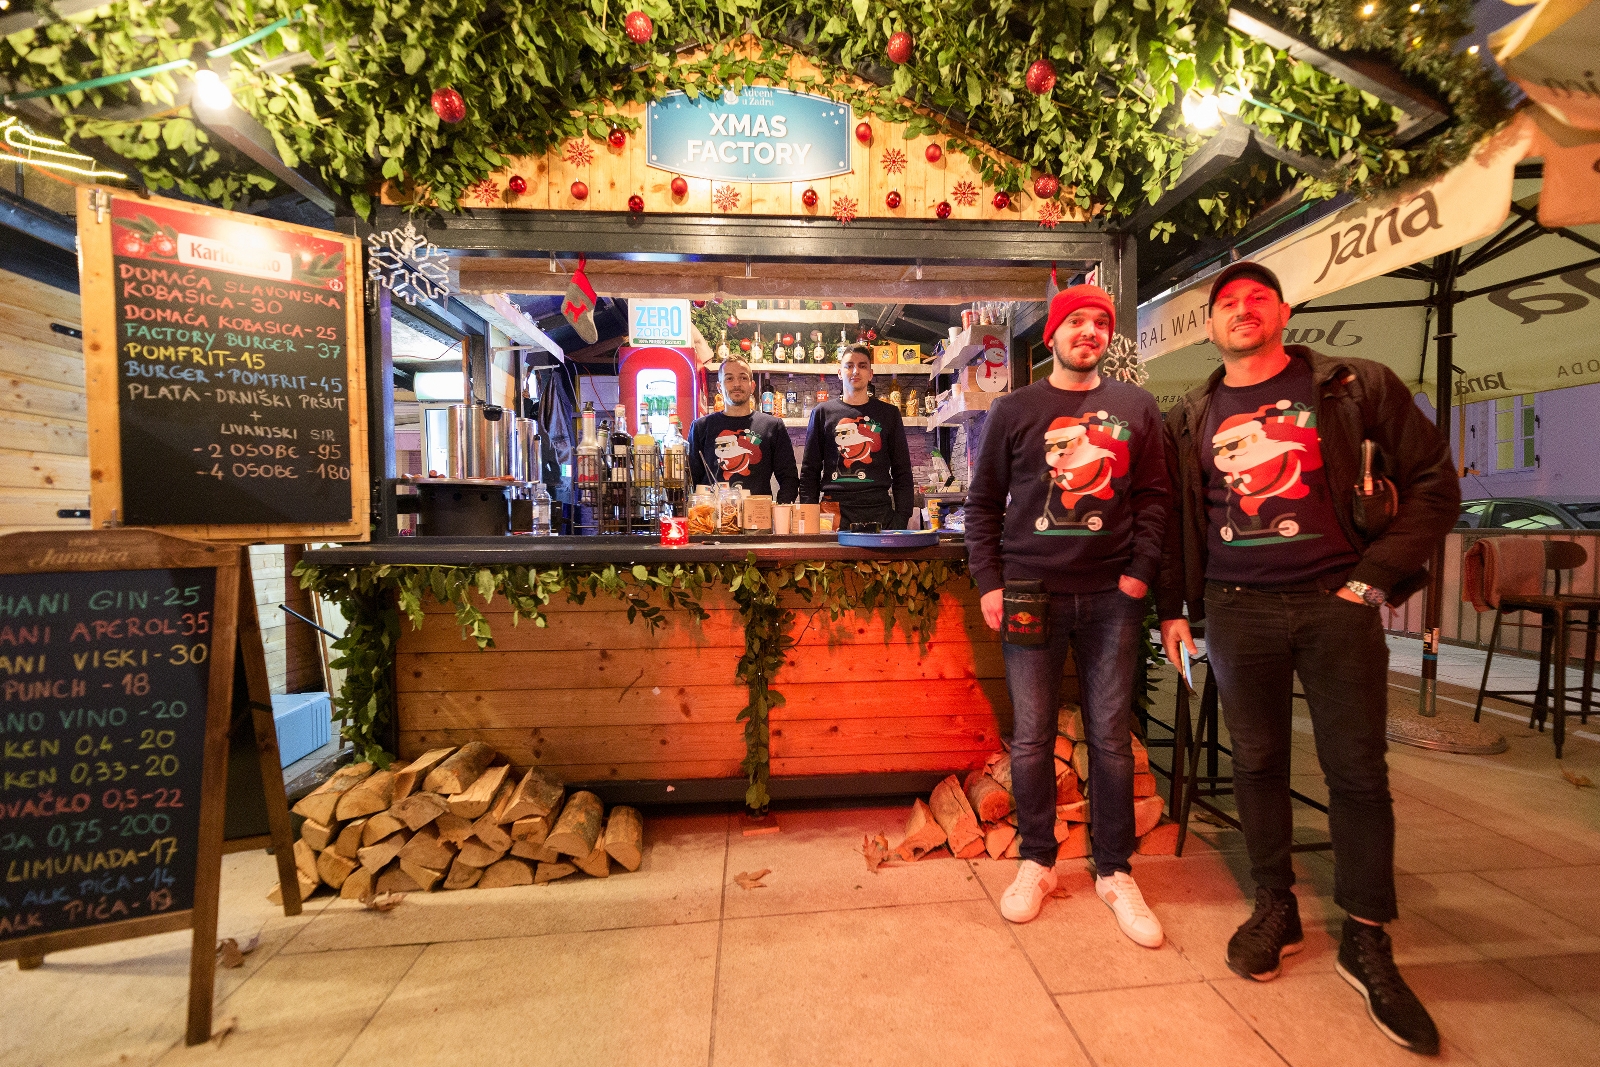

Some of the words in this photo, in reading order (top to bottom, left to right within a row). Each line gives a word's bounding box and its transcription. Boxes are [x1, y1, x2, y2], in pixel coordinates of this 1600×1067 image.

[709, 112, 787, 138] XMAS
[687, 140, 812, 165] FACTORY
[1313, 190, 1443, 284] Jana
[223, 281, 341, 309] SLAVONSKA
[635, 306, 682, 337] ZERO
[636, 327, 669, 338] zona
[124, 323, 217, 351] FACTORY
[224, 333, 297, 352] BURGER
[124, 361, 211, 384] BURGER
[299, 392, 346, 411] PRŠUT
[220, 423, 298, 440] LIVANJSKI
[310, 429, 335, 442] SIR
[230, 443, 300, 459] OSOBE
[232, 463, 299, 479] OSOBE
[4, 678, 87, 702] PUNCH
[58, 707, 128, 730] VINO
